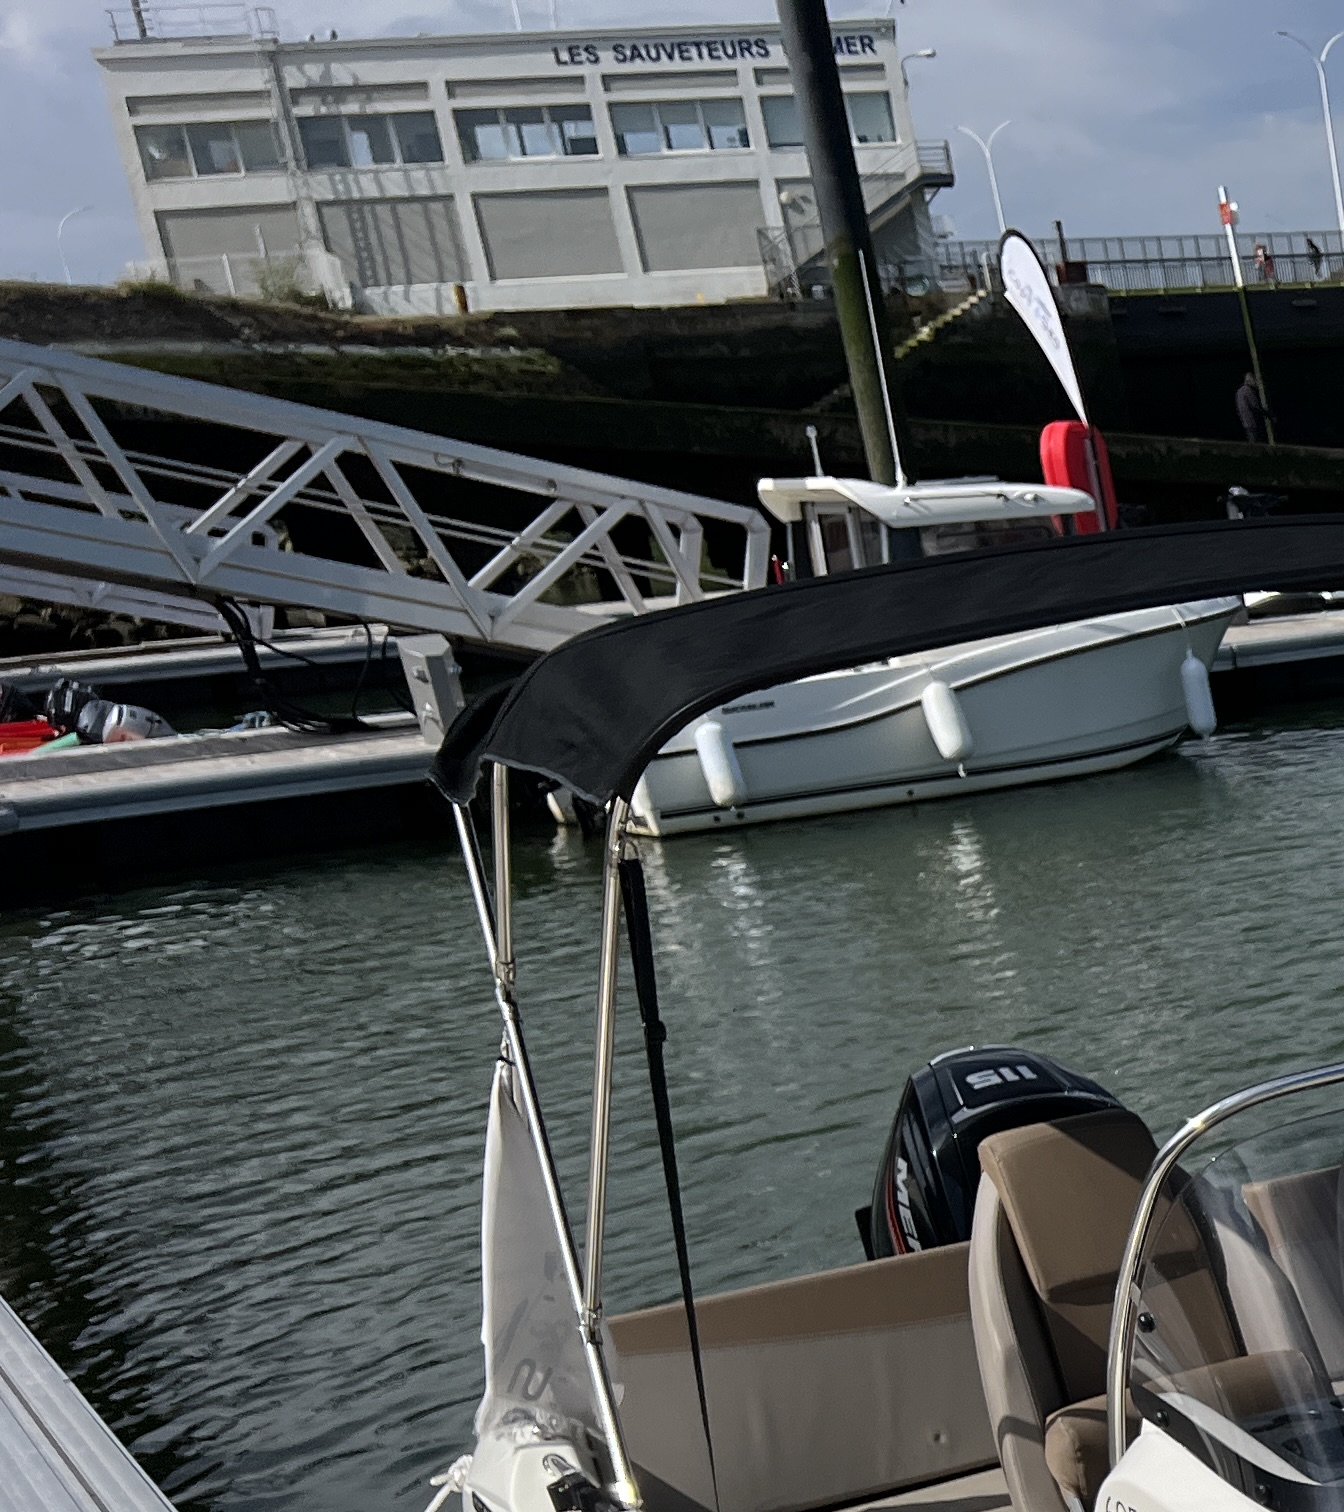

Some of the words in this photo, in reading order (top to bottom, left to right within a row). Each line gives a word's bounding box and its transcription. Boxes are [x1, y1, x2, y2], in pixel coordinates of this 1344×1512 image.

[551, 44, 601, 66] LES
[612, 38, 771, 64] SAUVETEURS
[966, 1065, 1037, 1090] 115
